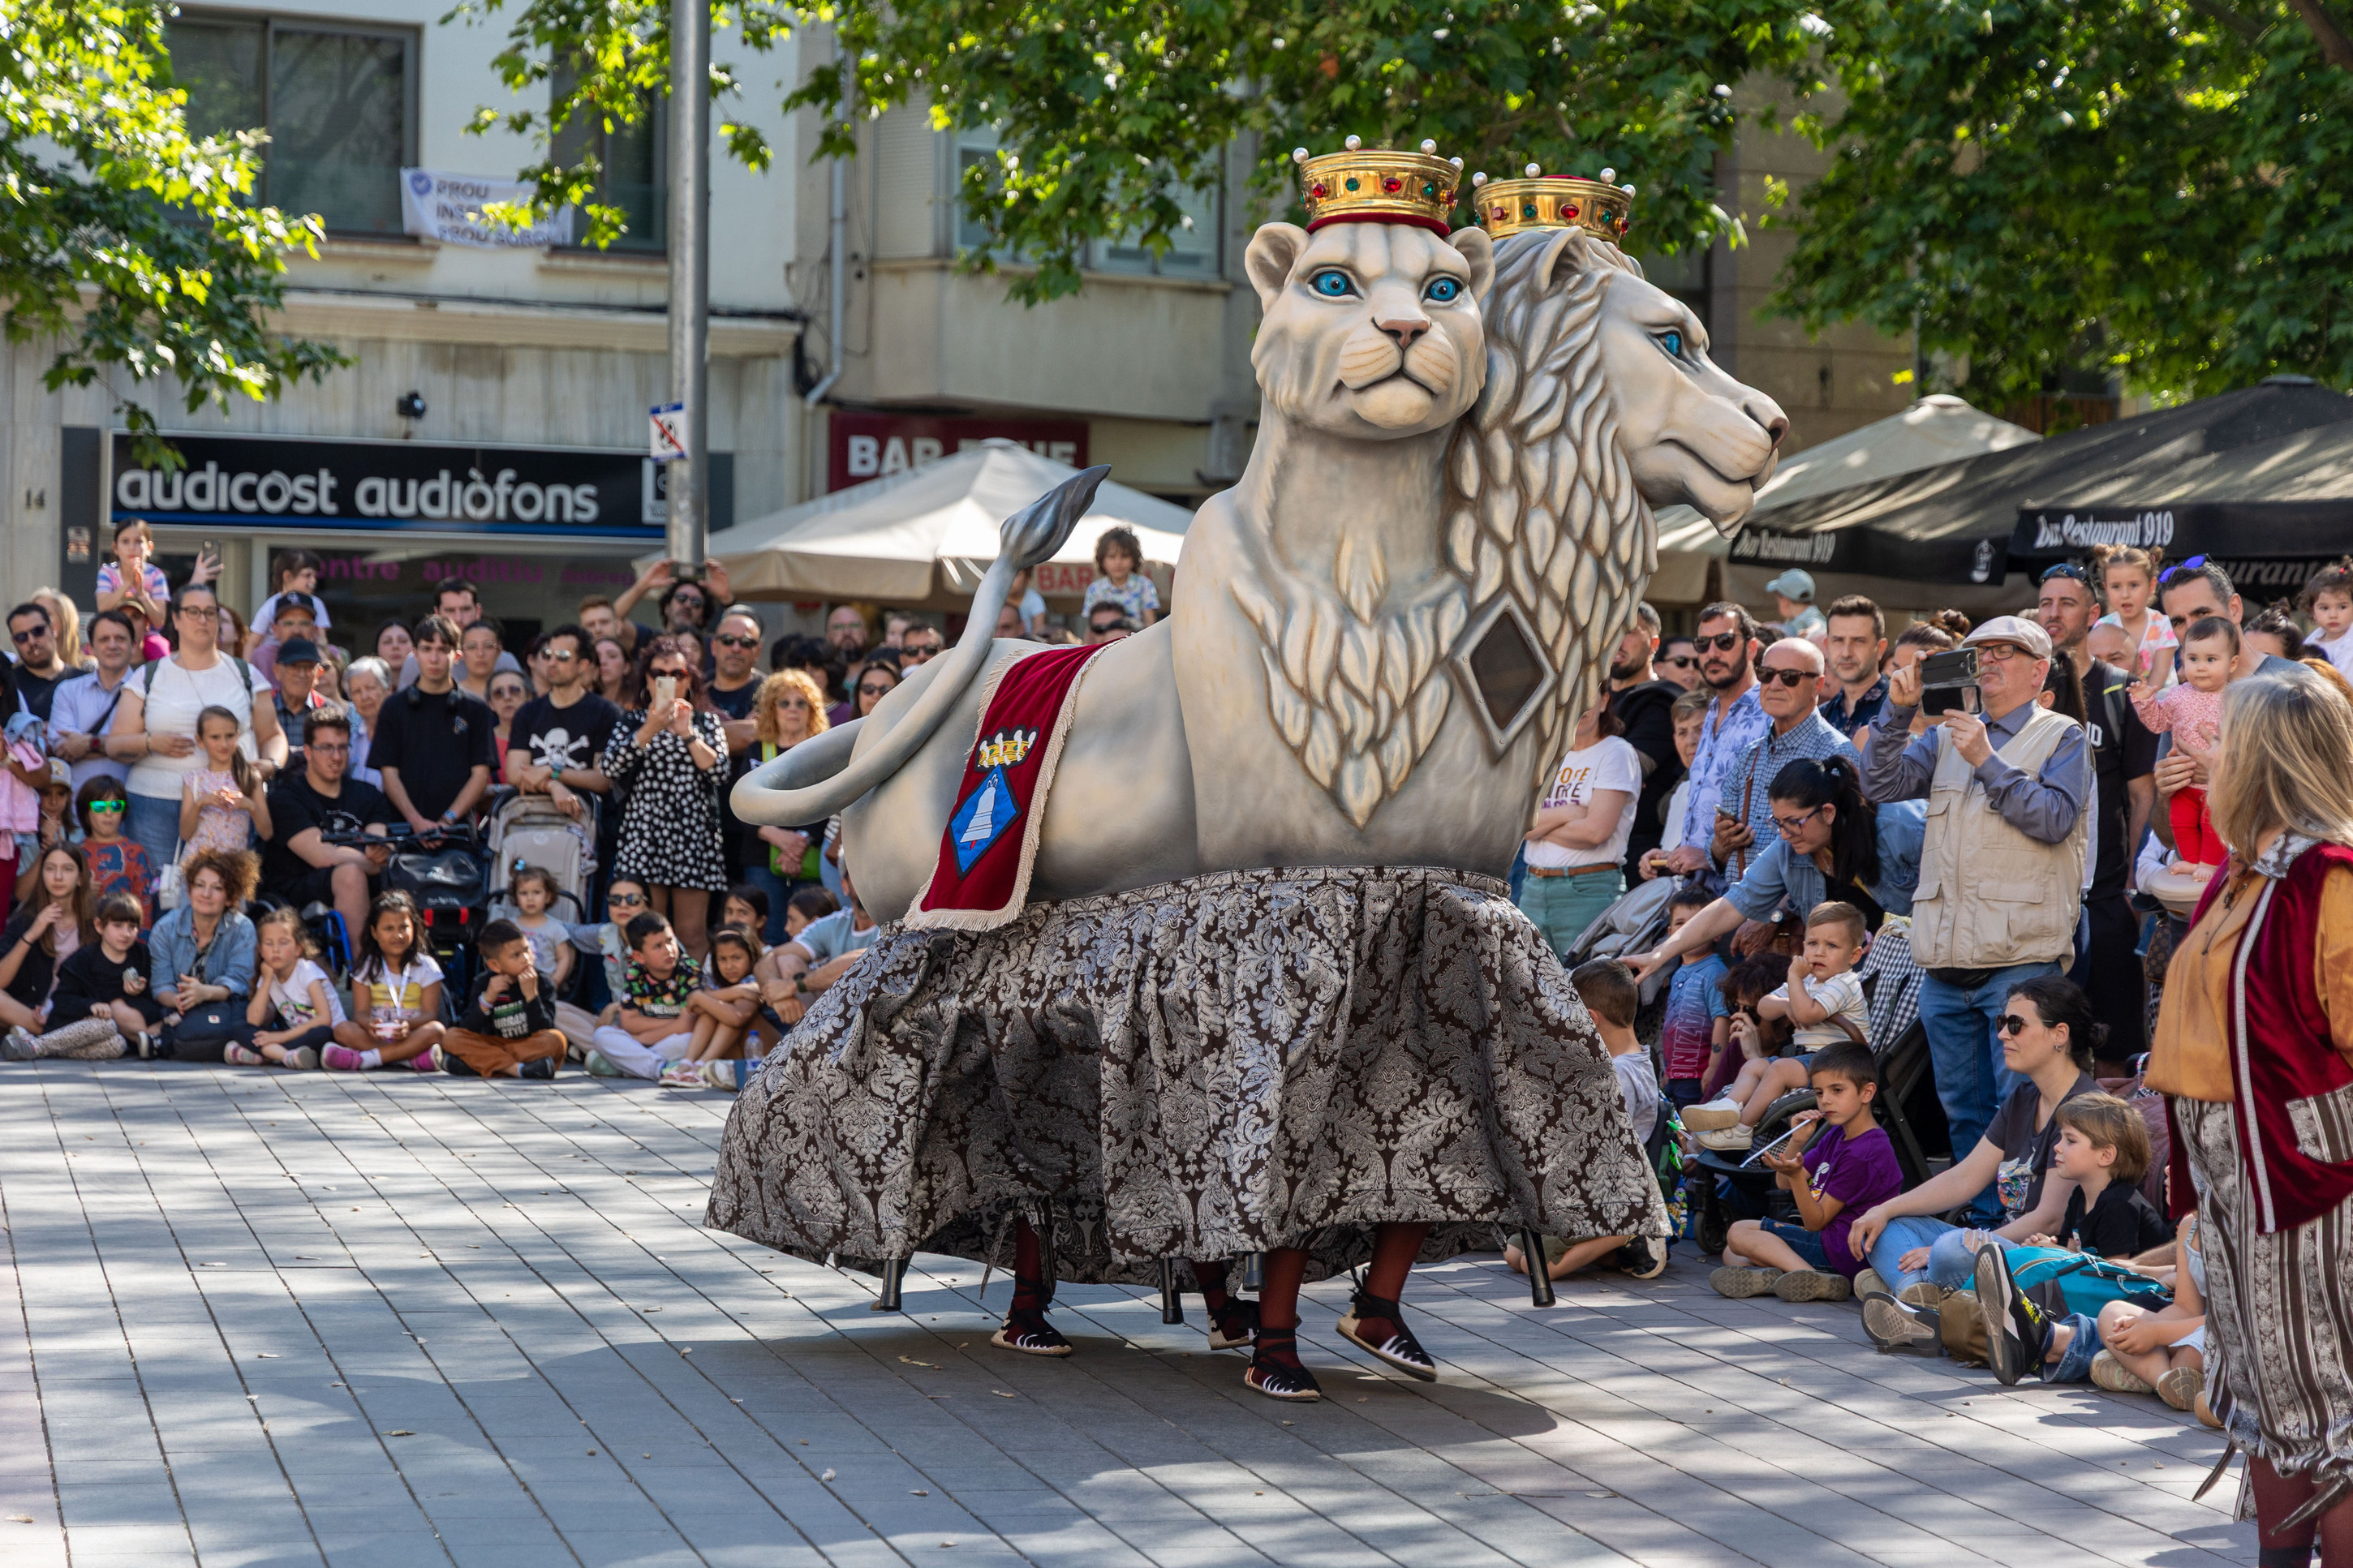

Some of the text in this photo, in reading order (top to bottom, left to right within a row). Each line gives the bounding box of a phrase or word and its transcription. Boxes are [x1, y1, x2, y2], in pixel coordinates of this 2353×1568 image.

[437, 180, 489, 200] PROU
[439, 225, 489, 244] PROU
[848, 435, 944, 477] BAR
[25, 488, 45, 509] 14
[117, 460, 600, 523] audicost audiòfons
[2142, 510, 2174, 547] 919
[1811, 531, 1836, 564] 919
[1037, 565, 1095, 592] BAR
